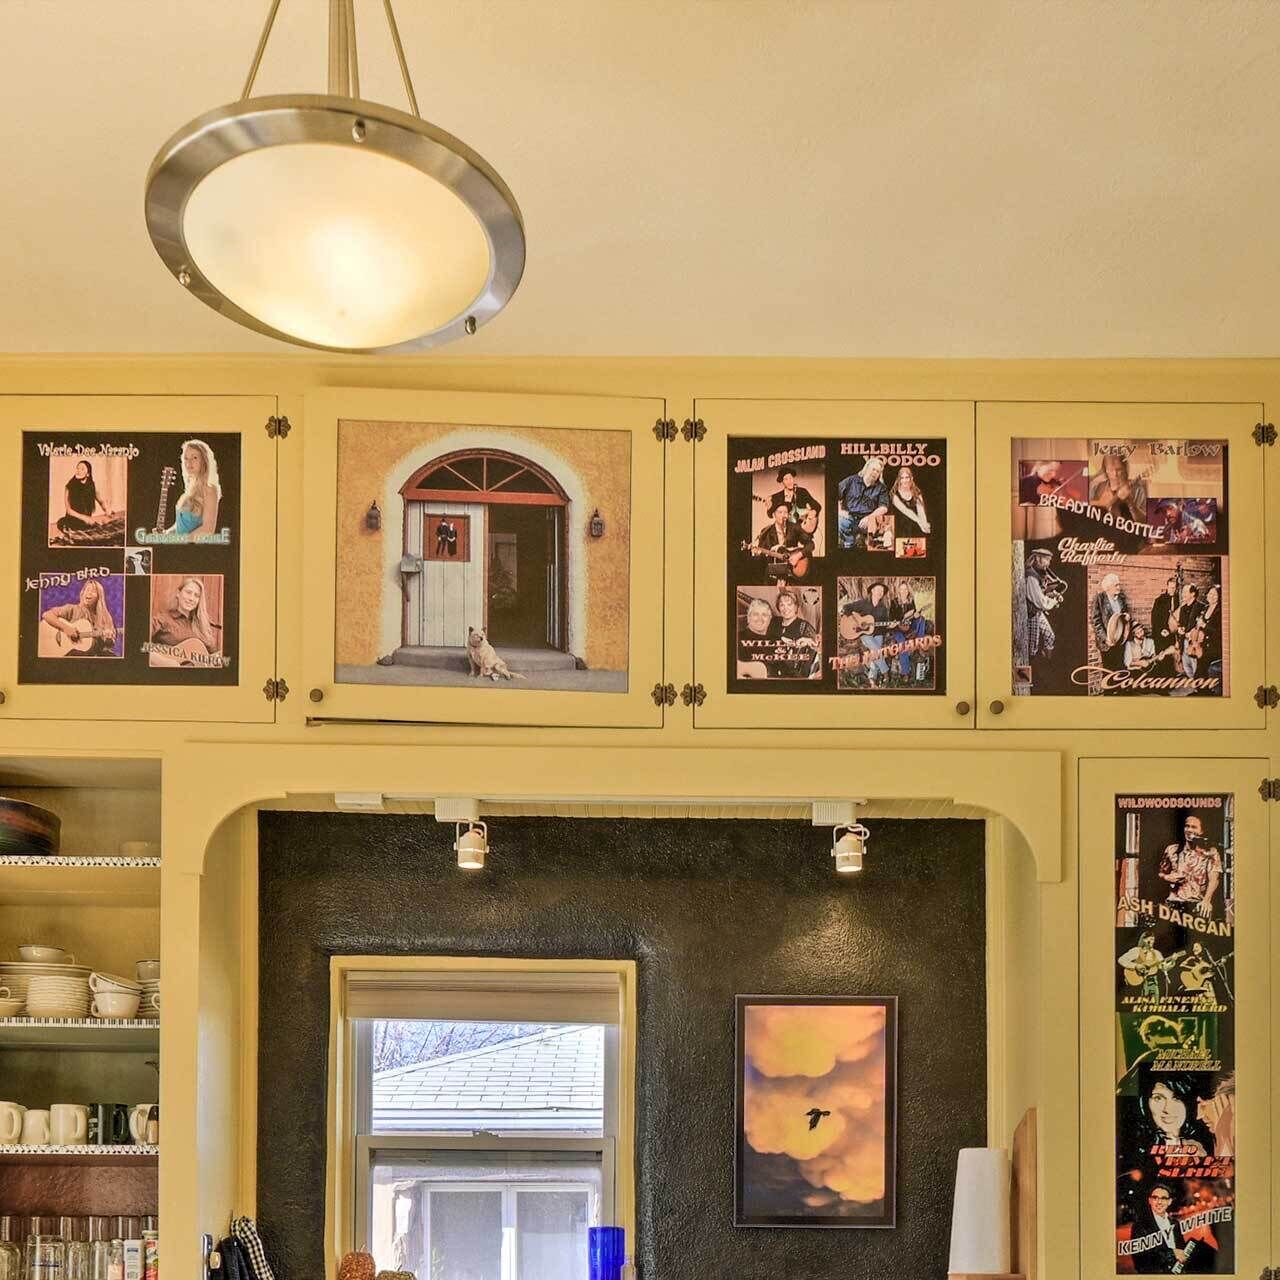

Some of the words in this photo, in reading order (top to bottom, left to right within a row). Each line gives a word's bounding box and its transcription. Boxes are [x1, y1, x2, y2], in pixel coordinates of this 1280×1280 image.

[768, 445, 827, 467] CROSSLAND
[840, 443, 928, 455] HILLBILLY
[1103, 513, 1114, 527] A
[1115, 517, 1165, 540] BOTTLE
[1058, 537, 1115, 552] Charlie
[1071, 666, 1220, 690] Colcannon
[1118, 797, 1222, 809] WILDWOODSOUNDS
[1117, 896, 1154, 915] ASH
[1158, 904, 1231, 936] DARGAN
[1118, 1224, 1175, 1255] KENNY
[1180, 1207, 1232, 1234] WHITE
